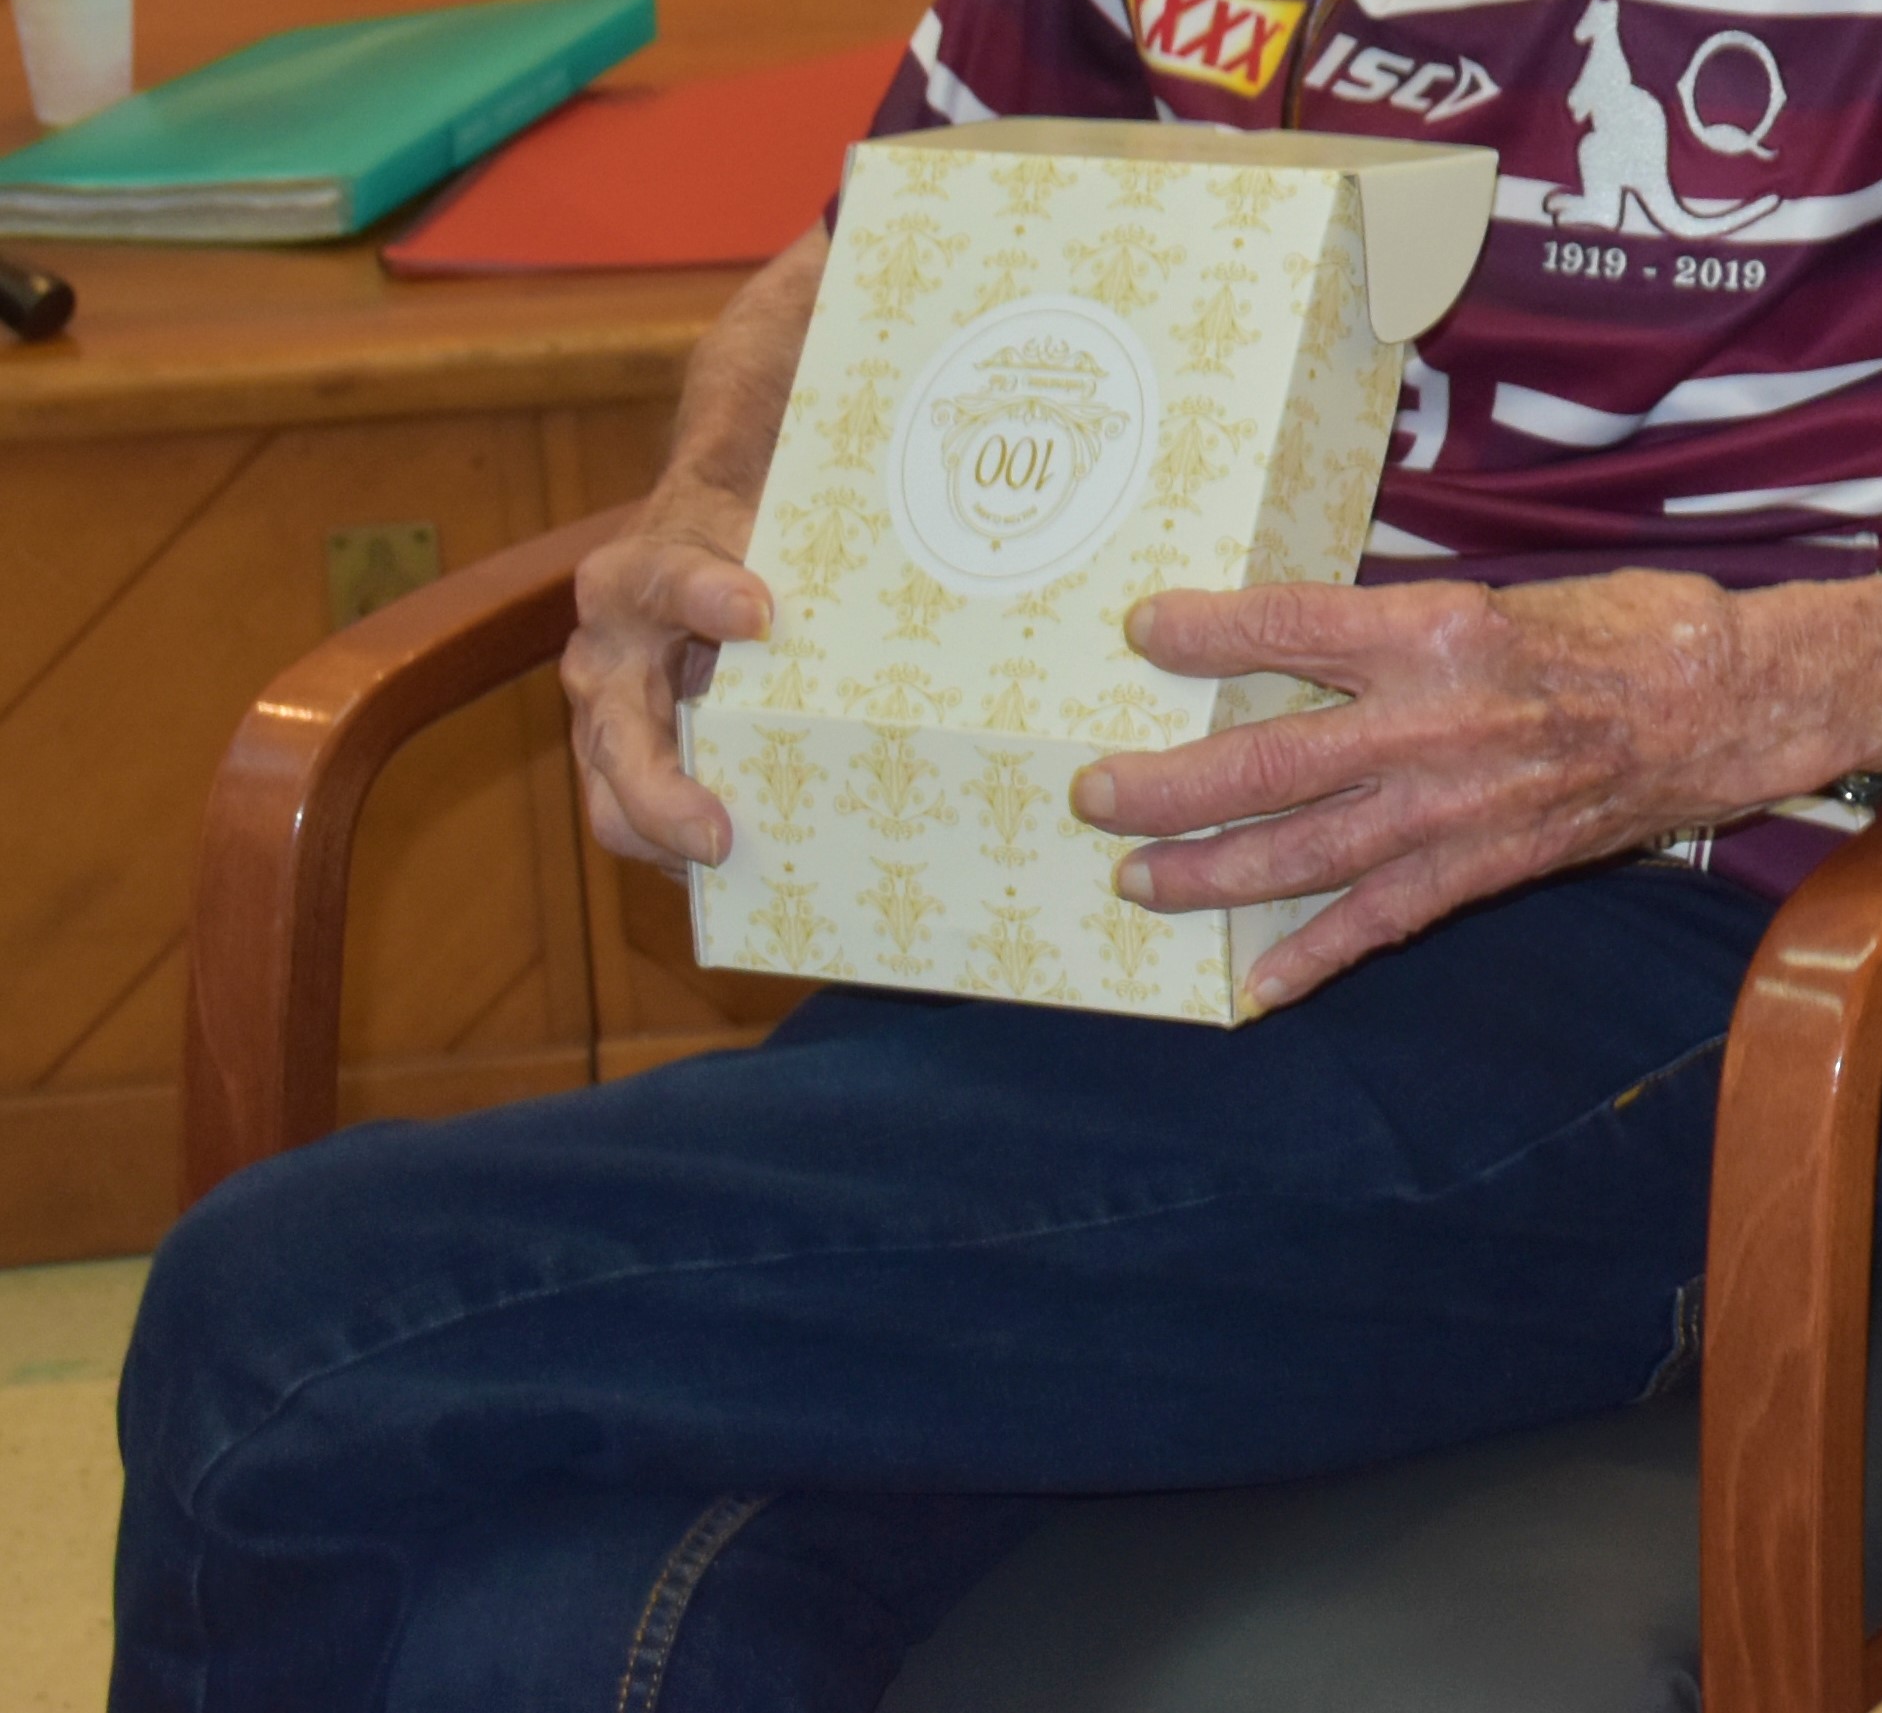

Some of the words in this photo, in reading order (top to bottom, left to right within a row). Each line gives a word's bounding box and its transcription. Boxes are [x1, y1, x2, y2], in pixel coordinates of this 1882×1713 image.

[1676, 29, 1788, 161] Q
[1542, 240, 1628, 281] 1919
[1642, 265, 1658, 279] -
[1672, 254, 1767, 292] 2019
[974, 434, 1055, 492] 100
